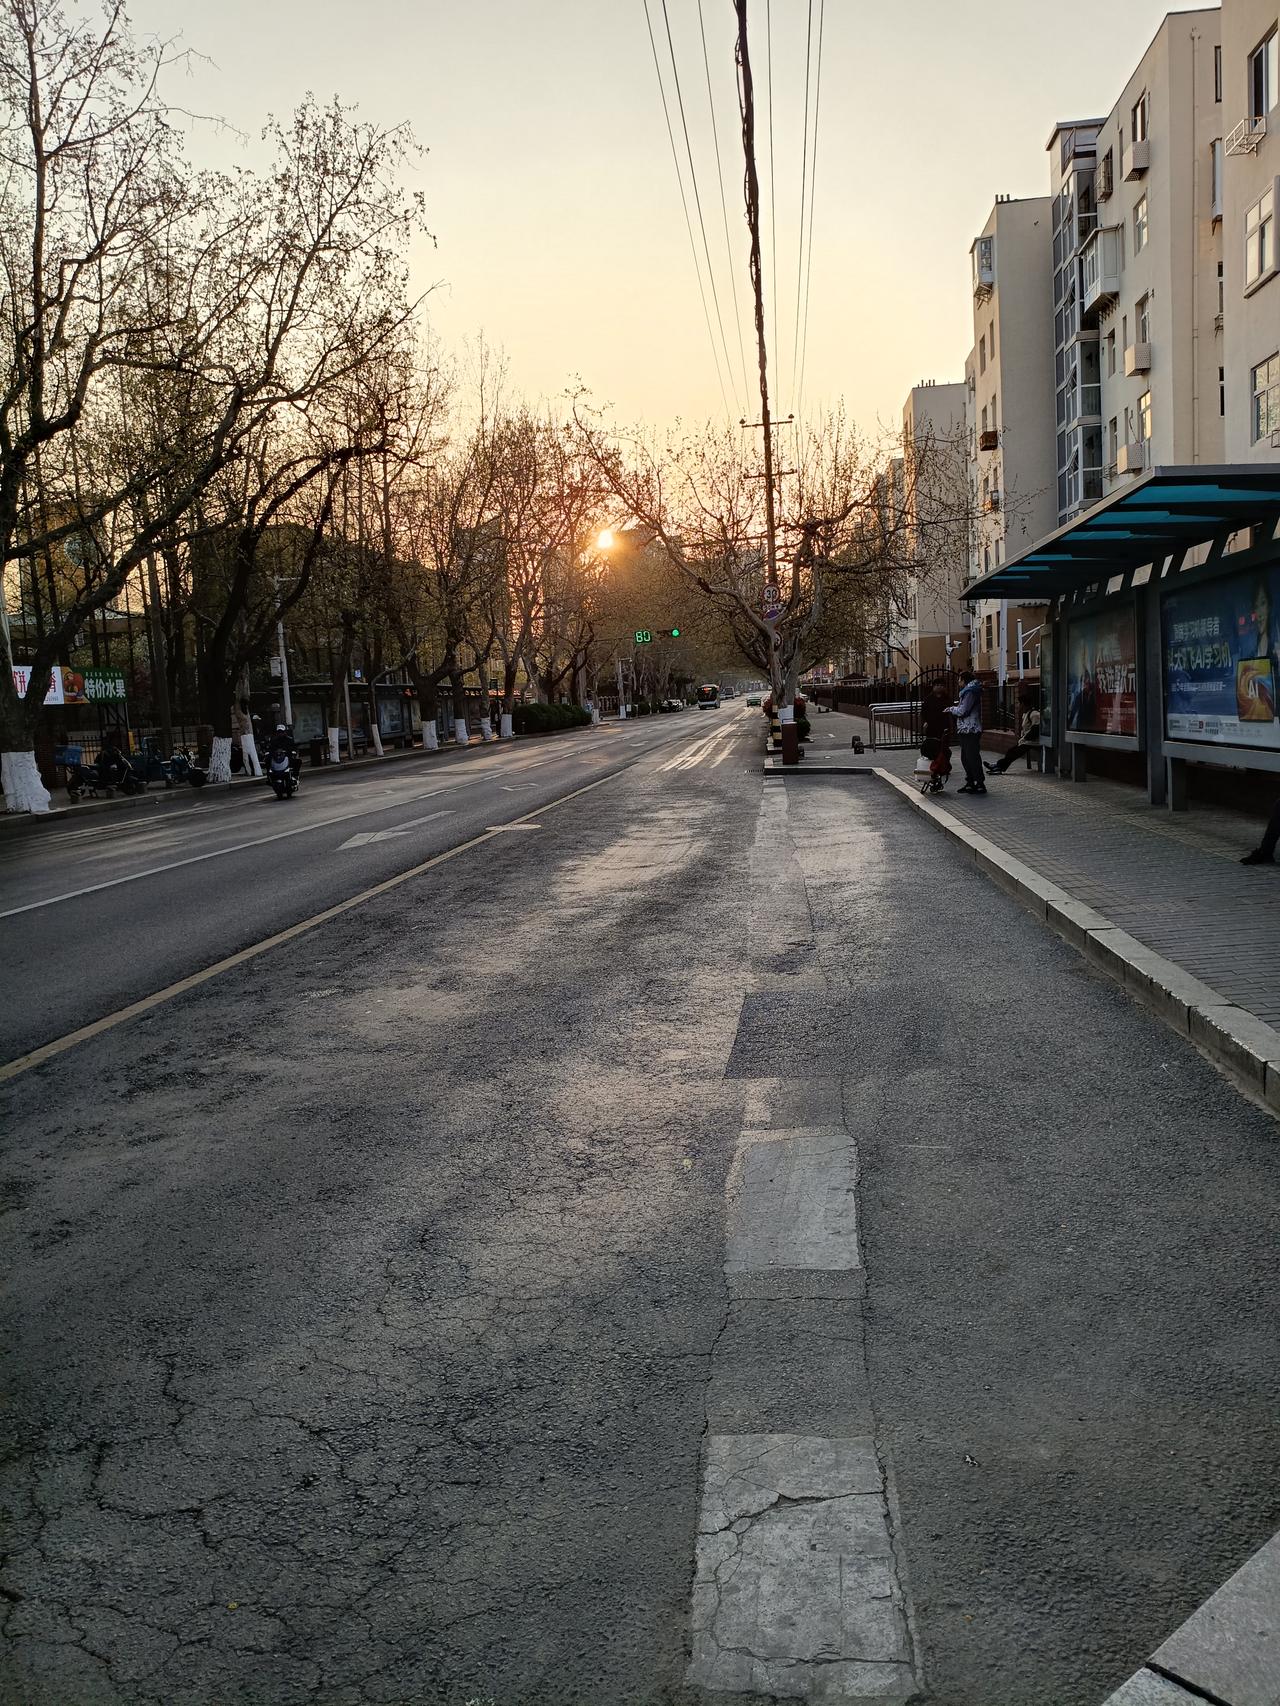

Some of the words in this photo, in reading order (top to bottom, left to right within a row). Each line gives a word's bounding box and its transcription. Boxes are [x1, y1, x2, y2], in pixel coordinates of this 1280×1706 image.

[636, 631, 651, 643] 80
[84, 678, 126, 699] 特价水果
[1248, 679, 1259, 699] AI
